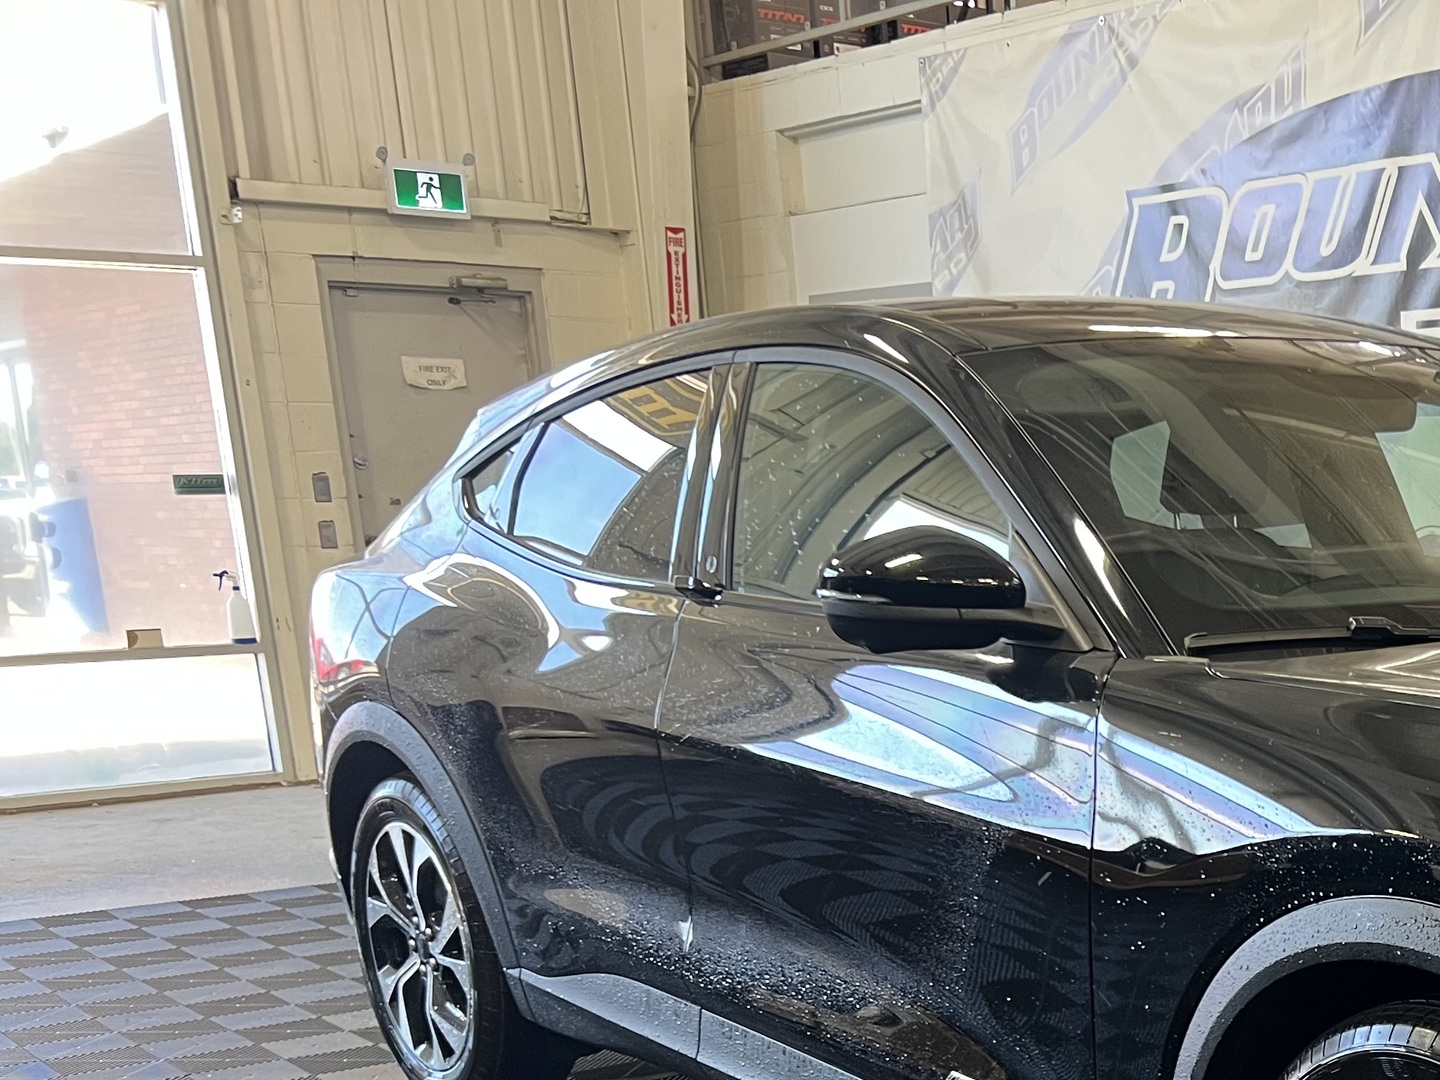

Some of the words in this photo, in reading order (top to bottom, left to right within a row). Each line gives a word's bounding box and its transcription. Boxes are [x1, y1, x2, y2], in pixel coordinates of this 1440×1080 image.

[757, 8, 805, 24] TITAN
[668, 236, 684, 248] FIRE
[673, 250, 684, 324] EXTINGUISHER
